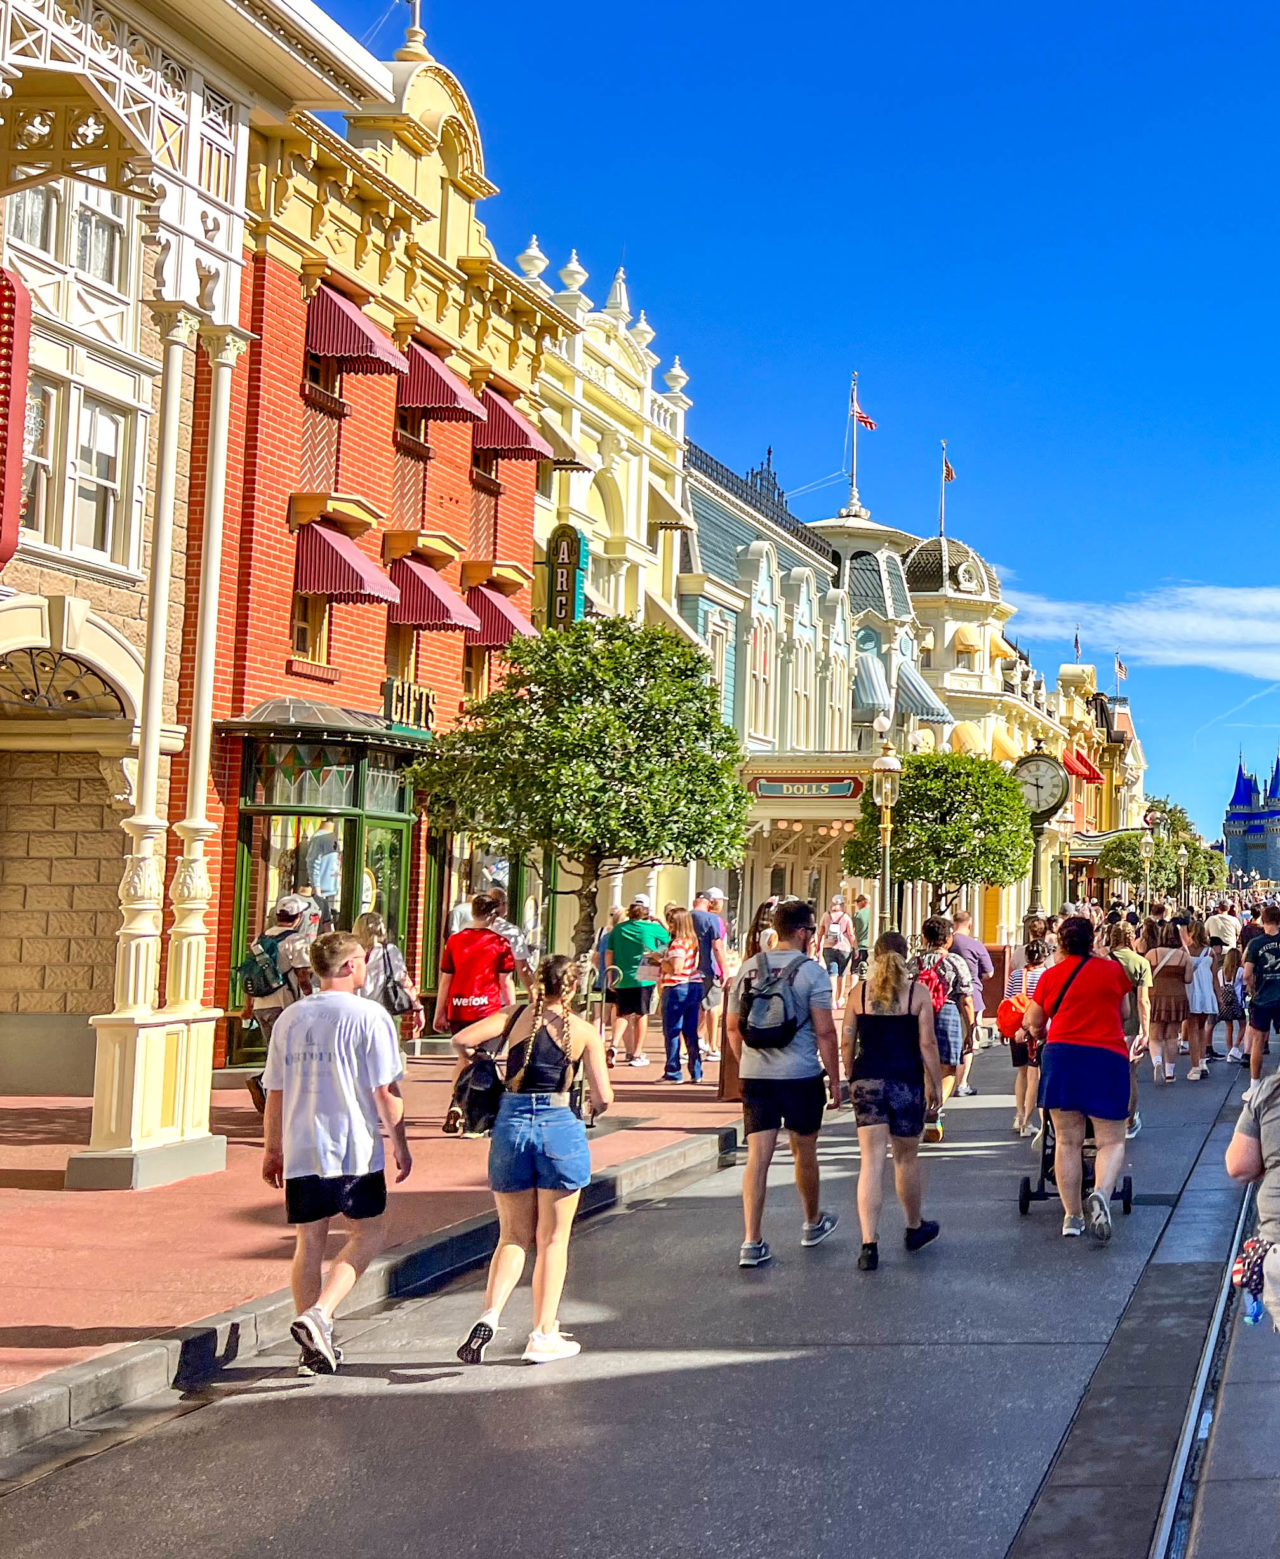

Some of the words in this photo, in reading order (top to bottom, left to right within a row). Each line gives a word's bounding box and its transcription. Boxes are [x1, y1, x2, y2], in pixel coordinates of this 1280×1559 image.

[391, 679, 438, 731] GIFTS
[782, 784, 830, 795] DOLLS
[452, 995, 489, 1006] wefox
